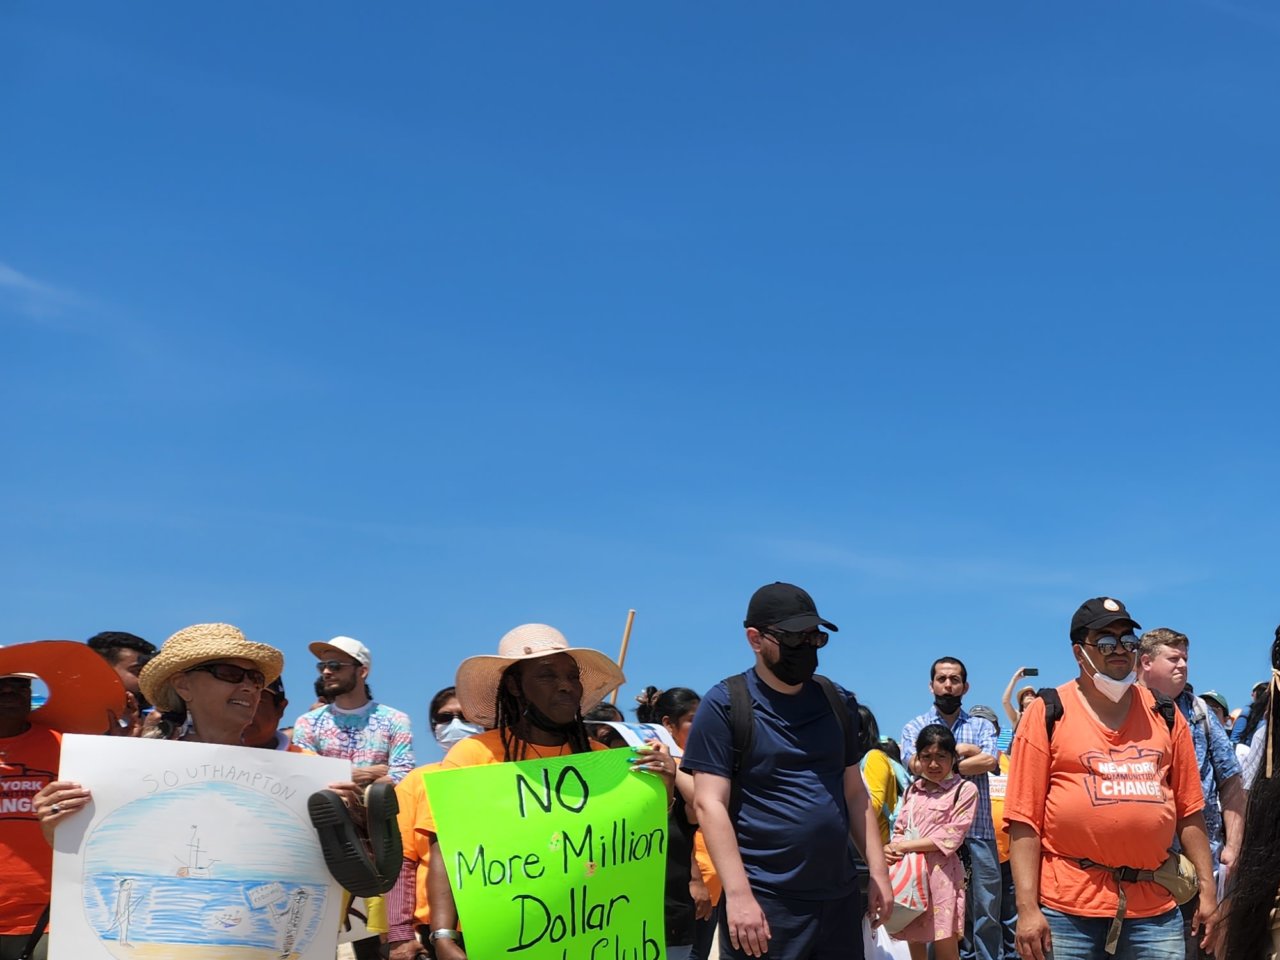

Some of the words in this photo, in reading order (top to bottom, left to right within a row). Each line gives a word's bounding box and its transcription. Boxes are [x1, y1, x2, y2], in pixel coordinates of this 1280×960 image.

[0, 780, 43, 791] YORK
[142, 763, 297, 801] SOUTHAMPTON
[1098, 762, 1127, 773] NEW
[515, 765, 589, 817] NO
[1101, 781, 1162, 796] CHANGE
[457, 844, 545, 889] More
[562, 818, 664, 873] Million
[507, 885, 629, 952] Dollar
